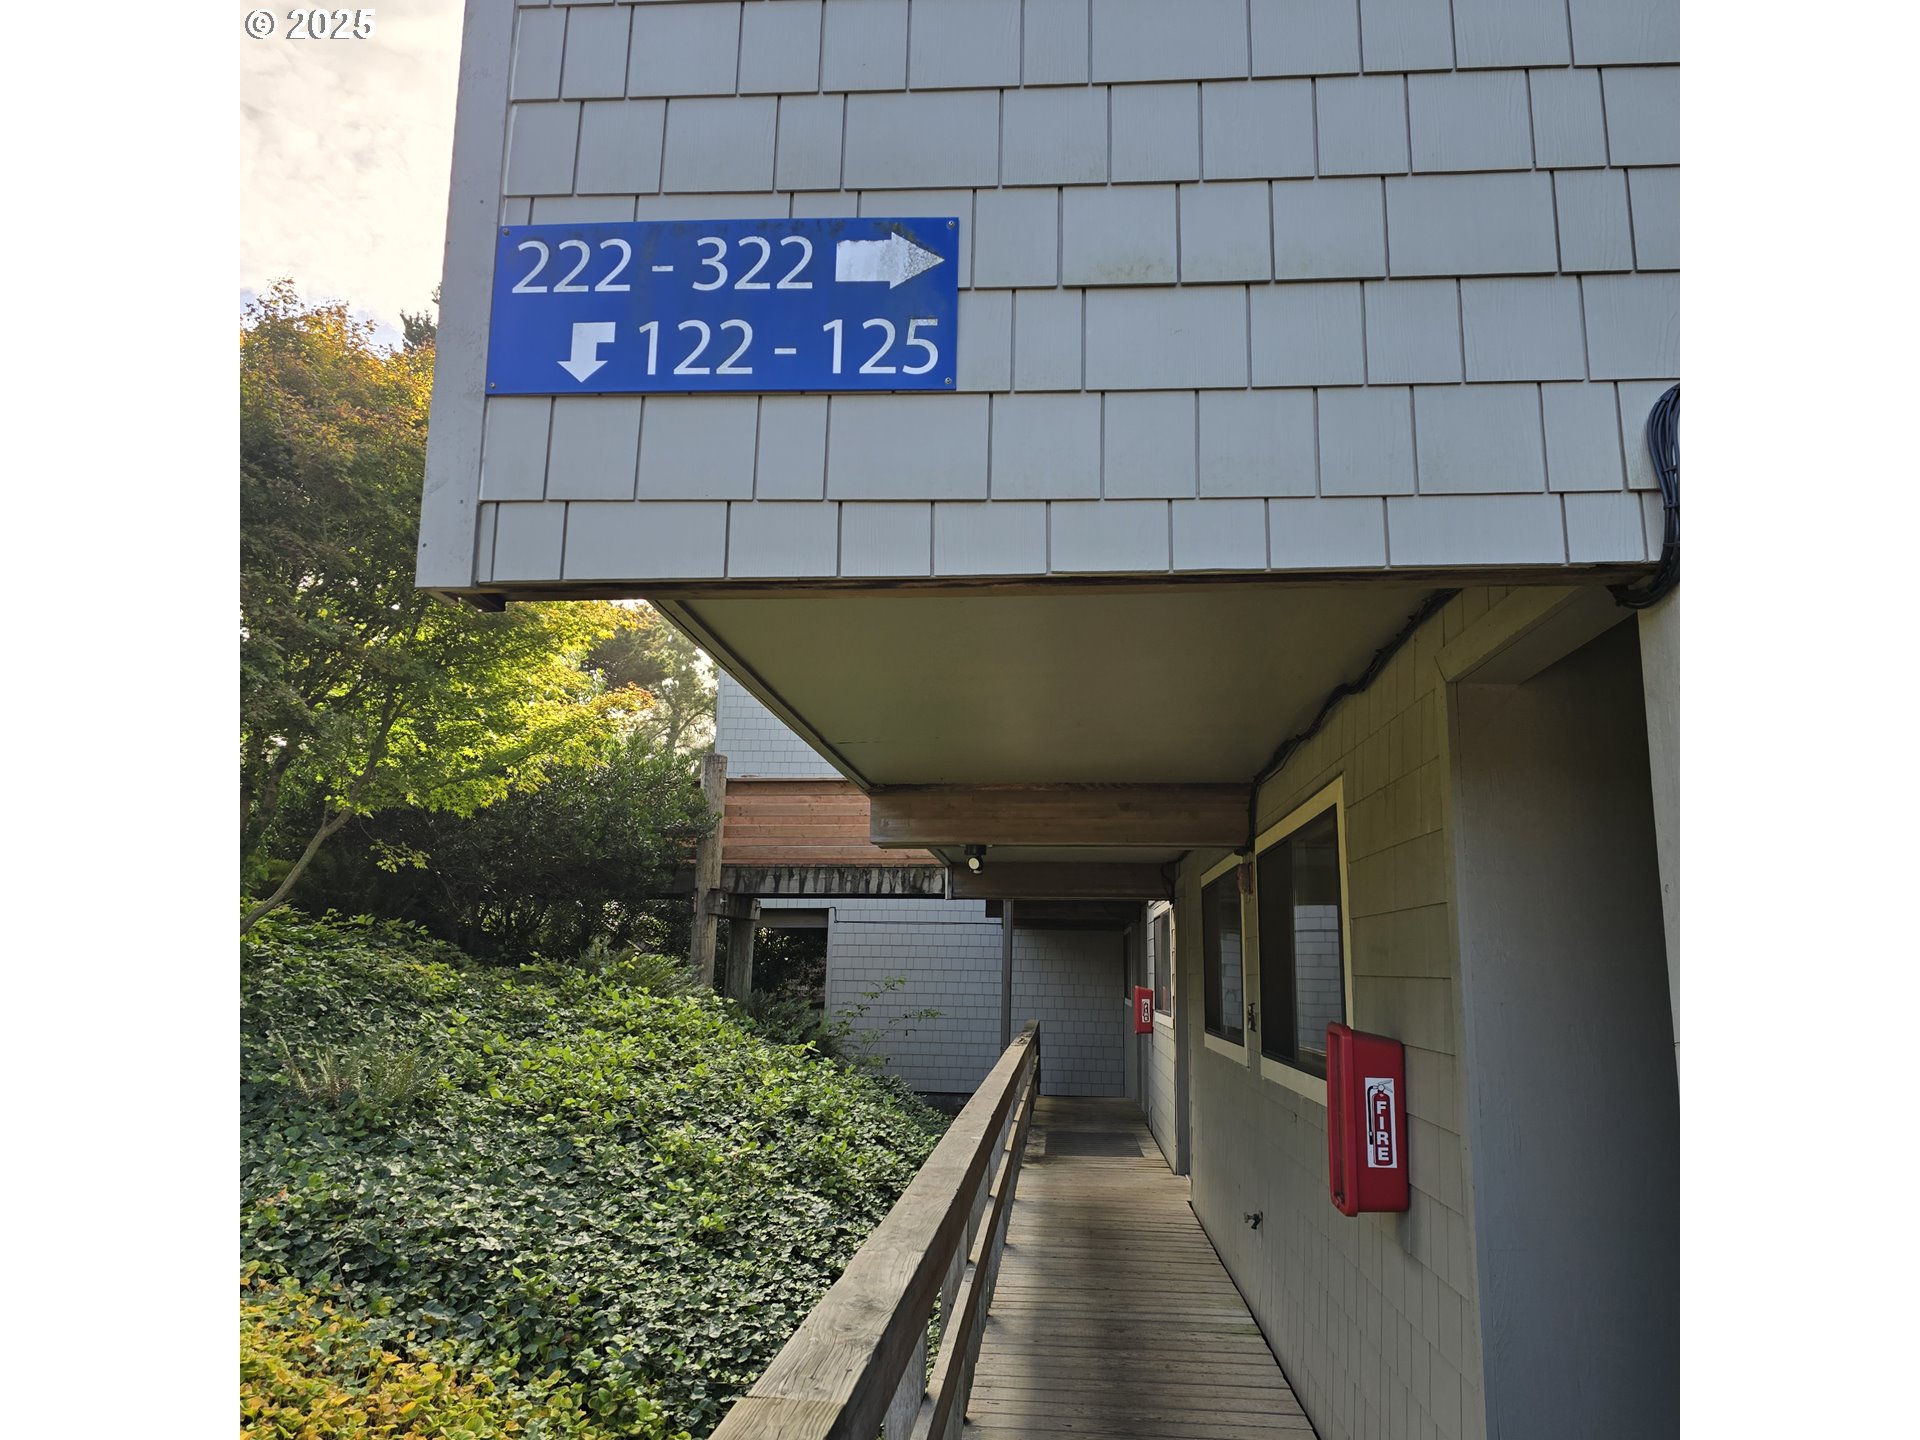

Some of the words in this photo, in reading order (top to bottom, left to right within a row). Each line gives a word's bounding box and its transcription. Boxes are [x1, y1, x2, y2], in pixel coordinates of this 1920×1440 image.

[512, 238, 631, 294] 222
[651, 265, 674, 273] -
[692, 235, 813, 291] 322
[638, 319, 753, 375] 122
[773, 347, 797, 355] -
[822, 318, 939, 375] 125
[1375, 1100, 1390, 1162] FIRE
